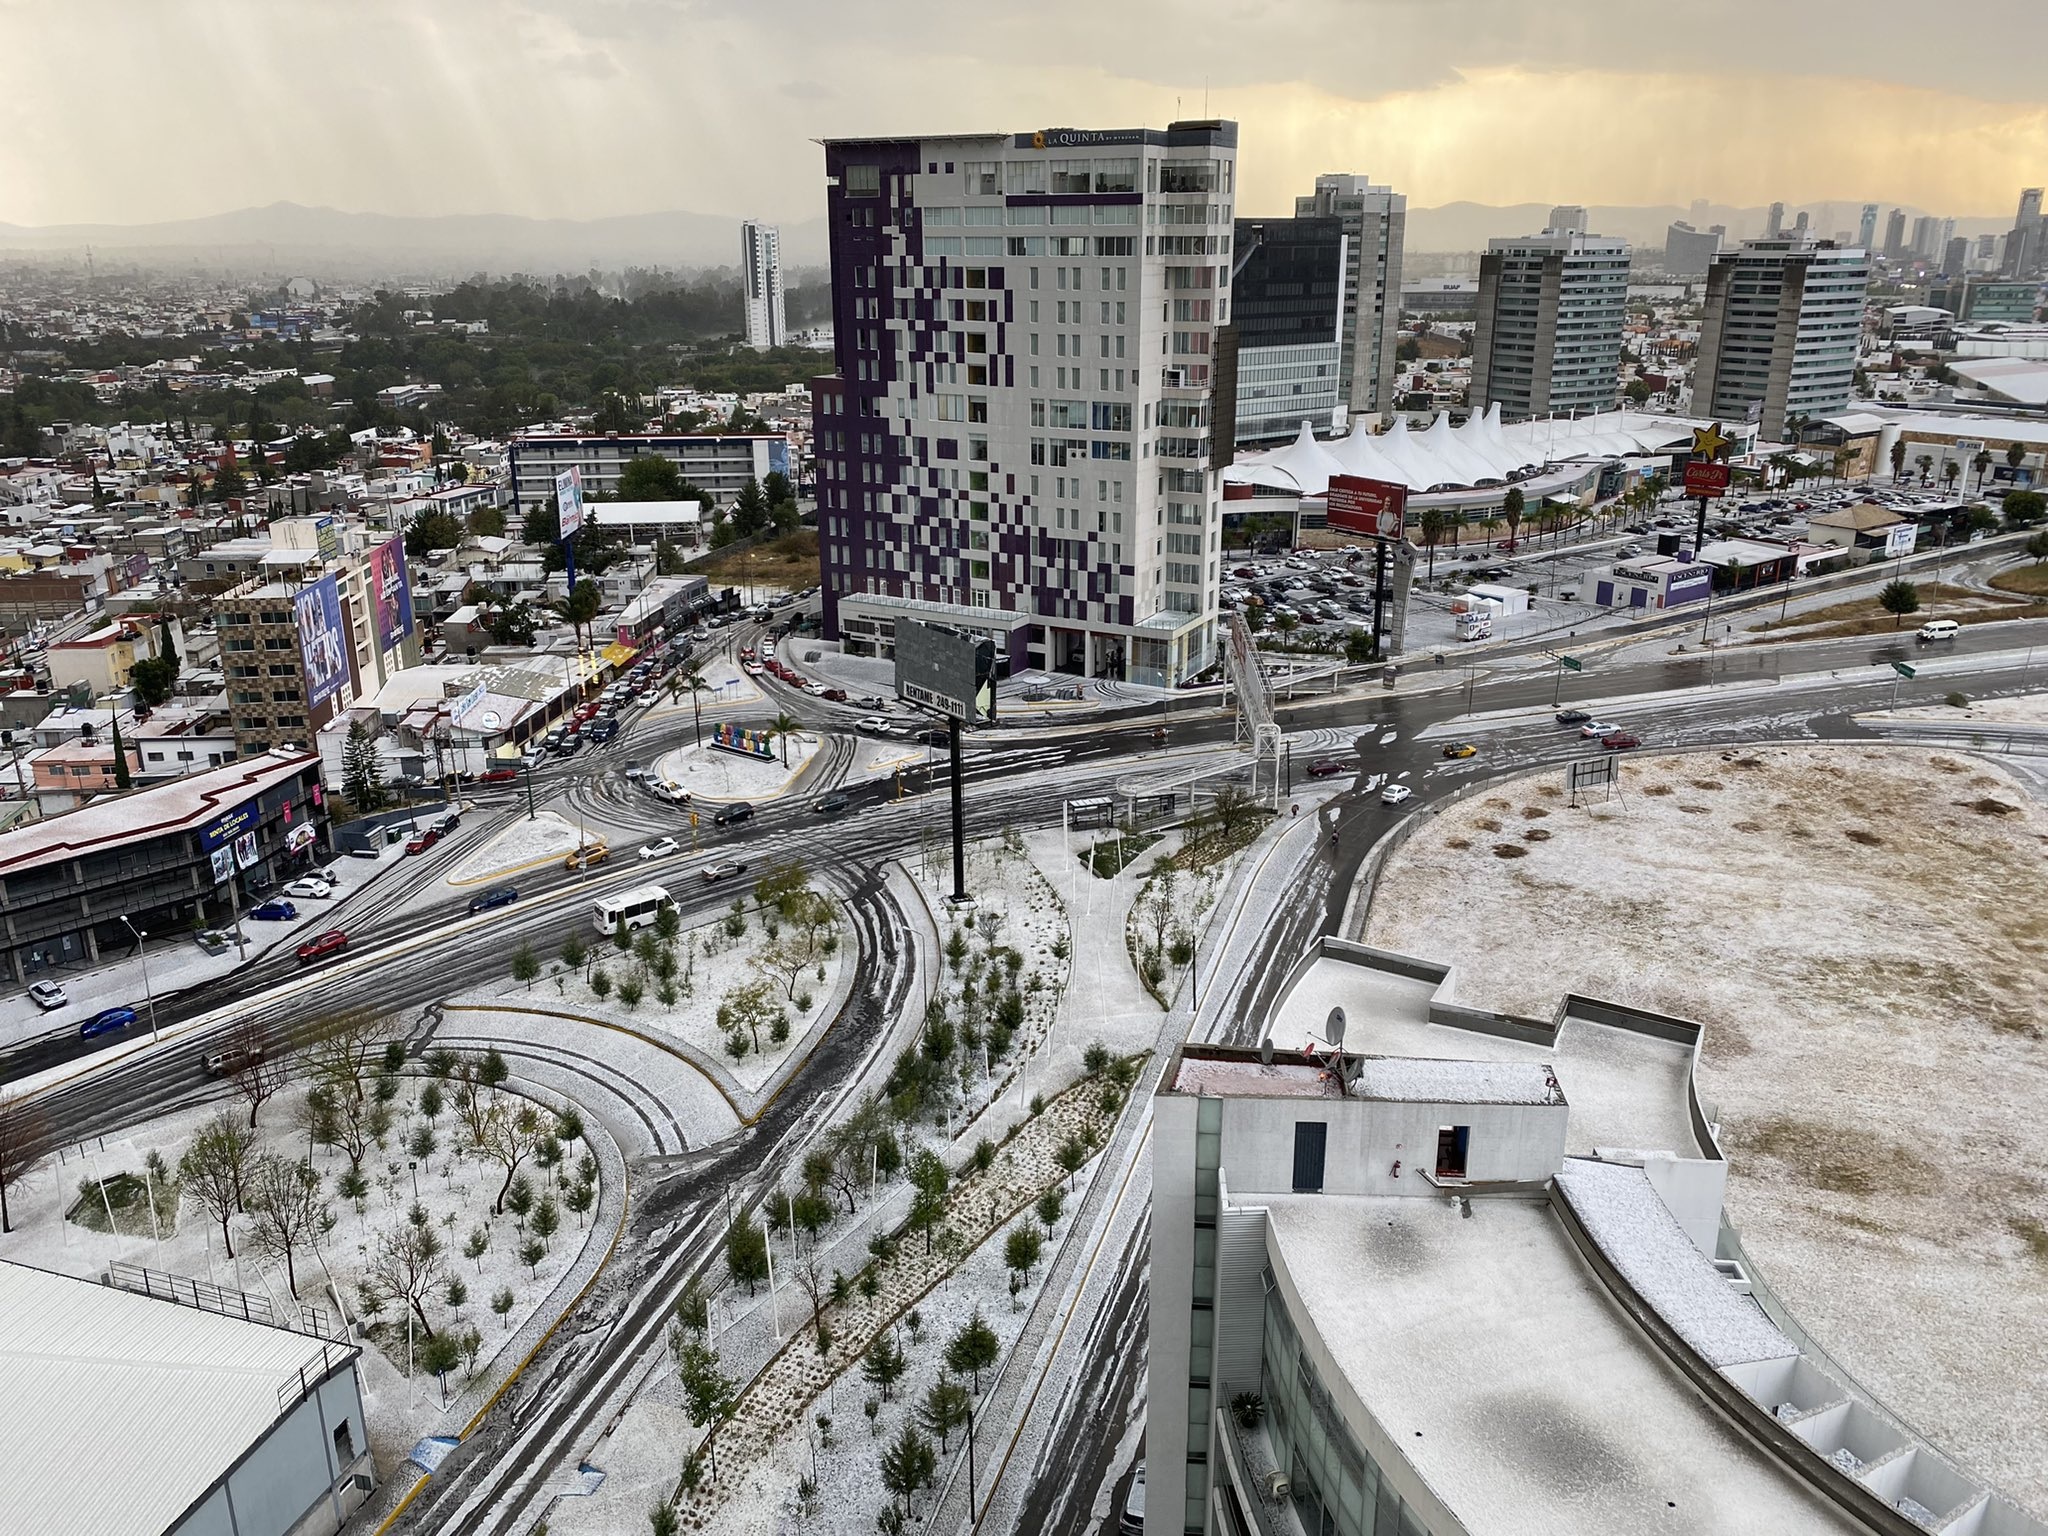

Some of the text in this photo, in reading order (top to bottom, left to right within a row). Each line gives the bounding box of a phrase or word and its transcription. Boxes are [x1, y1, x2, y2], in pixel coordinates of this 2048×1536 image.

[1060, 133, 1104, 145] QUINTA
[906, 684, 964, 716] RENTAME 249-1111
[230, 812, 249, 827] LOCALES
